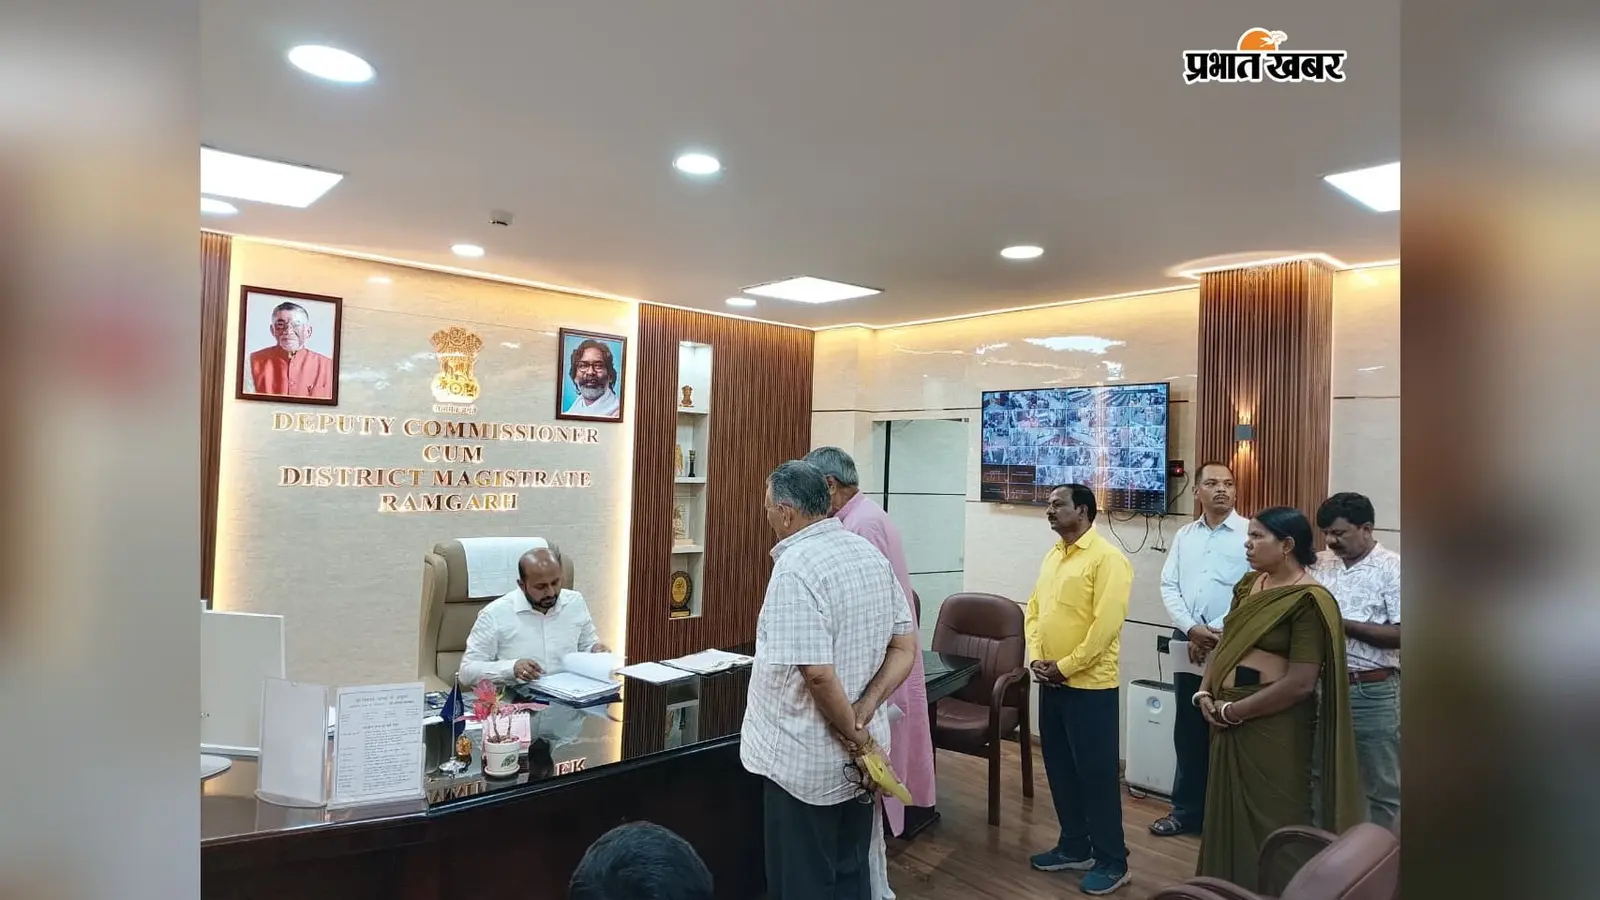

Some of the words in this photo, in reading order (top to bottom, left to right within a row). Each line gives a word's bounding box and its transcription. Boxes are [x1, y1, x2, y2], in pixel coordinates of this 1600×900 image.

[272, 411, 395, 436] DEPUTY
[403, 418, 599, 444] COMMISSIONER
[422, 443, 484, 463] CUM
[278, 465, 424, 488] DISTRICT
[431, 468, 592, 488] MAGISTRATE
[377, 492, 519, 512] RAMGARH
